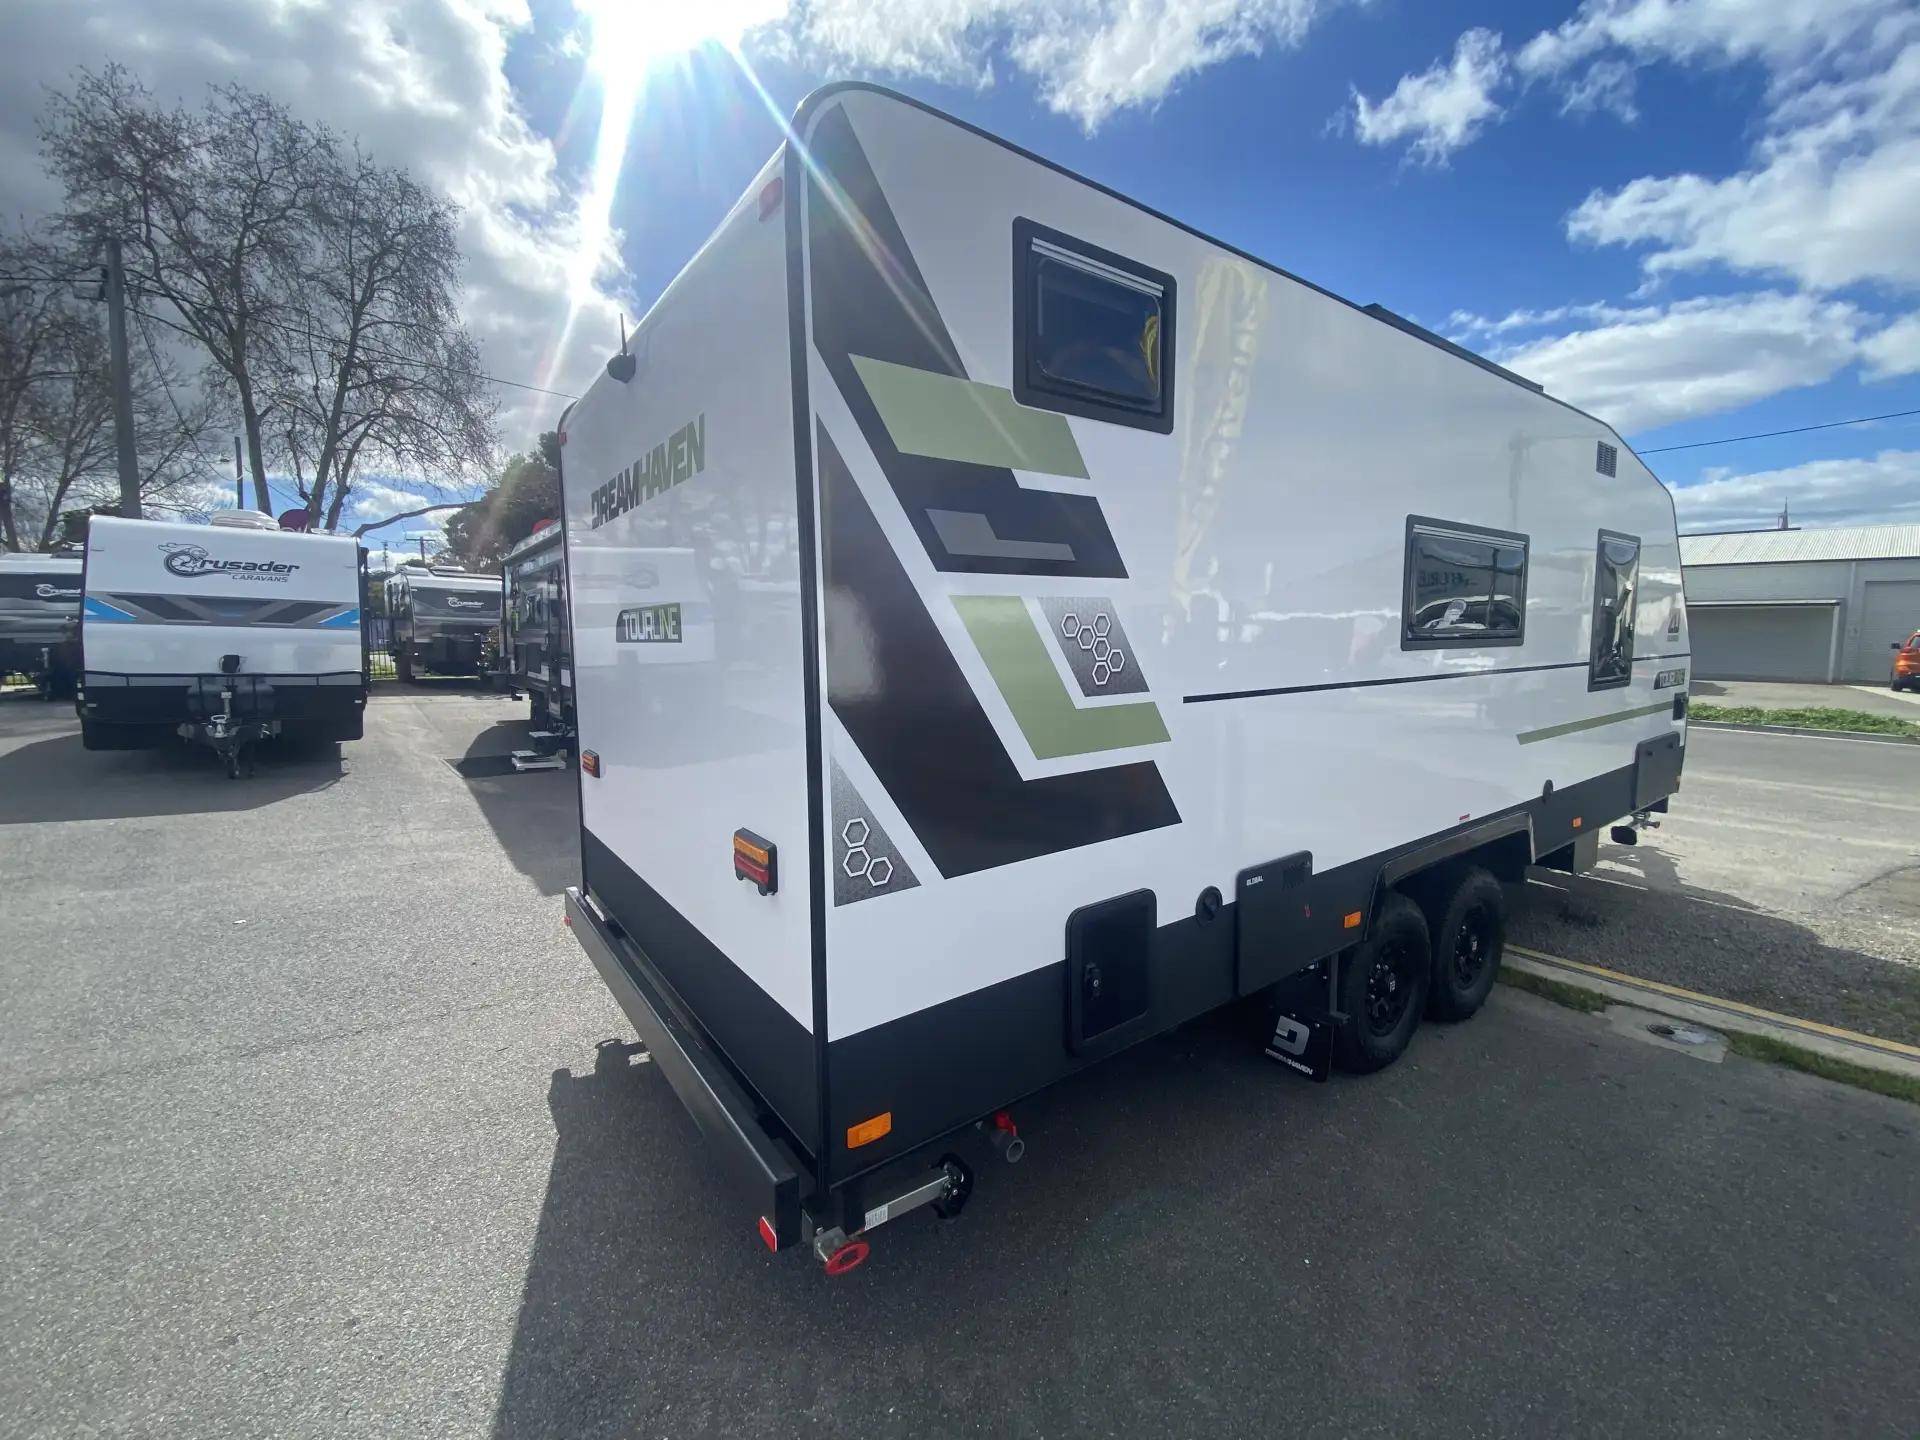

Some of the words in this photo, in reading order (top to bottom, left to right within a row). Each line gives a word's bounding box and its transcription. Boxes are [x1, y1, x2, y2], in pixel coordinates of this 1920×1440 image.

[591, 412, 705, 531] DREAMHAVEN
[164, 550, 300, 578] Crusader
[231, 574, 289, 583] CARAVANS
[36, 586, 82, 597] Crusad
[622, 607, 679, 640] TOURLINE
[1246, 875, 1264, 887] GLOBAL
